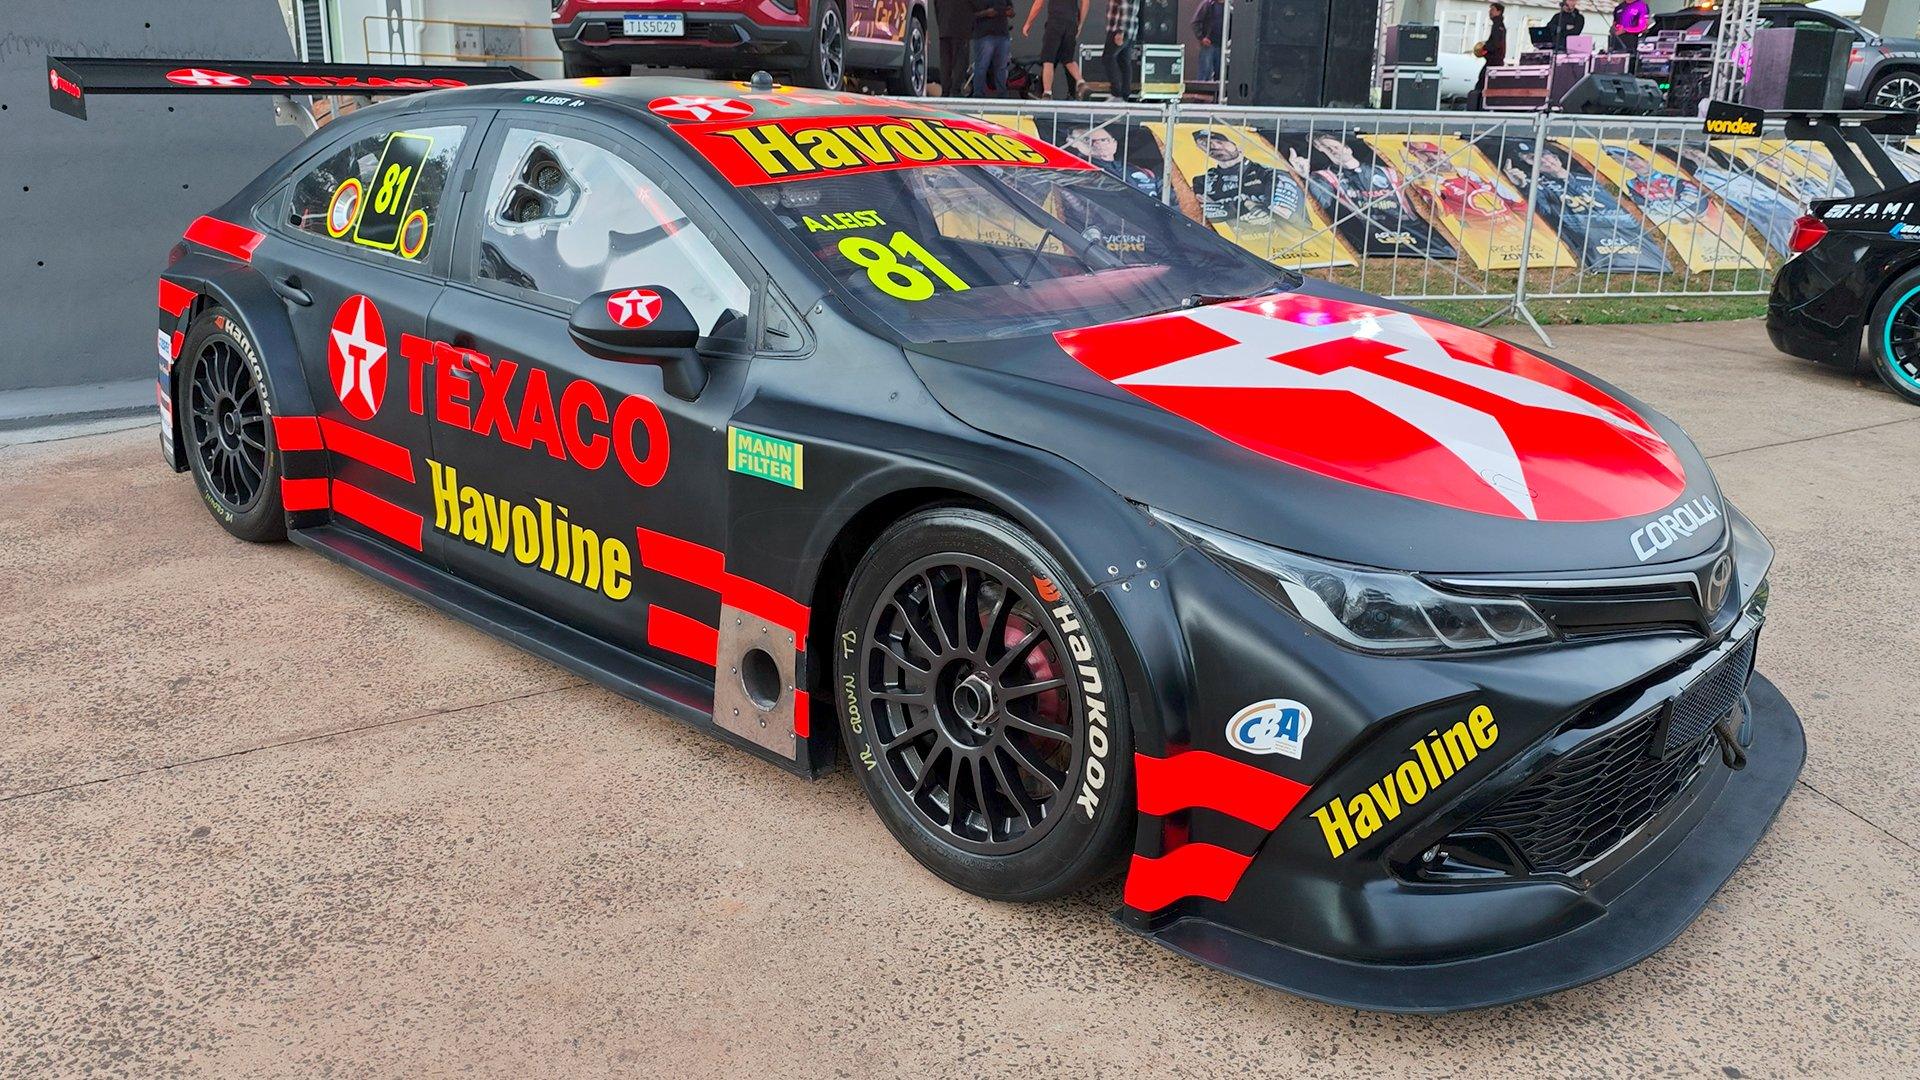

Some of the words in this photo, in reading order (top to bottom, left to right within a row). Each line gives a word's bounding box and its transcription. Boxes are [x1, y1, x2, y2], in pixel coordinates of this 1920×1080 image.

[630, 21, 676, 33] TIS5C29
[713, 117, 1048, 176] Havoline
[374, 163, 412, 215] 81
[802, 209, 887, 233] A.LEIST
[837, 231, 972, 301] 81
[224, 319, 272, 416] Hankook
[400, 333, 671, 488] TEXACO
[738, 434, 792, 463] MANN
[738, 452, 792, 482] FILTER
[425, 458, 632, 601] Havoline
[1629, 494, 1722, 562] COROLLA
[1052, 604, 1109, 820] Hankook
[1239, 708, 1300, 744] CBA
[859, 743, 877, 771] VR
[1308, 704, 1499, 859] Havoline
